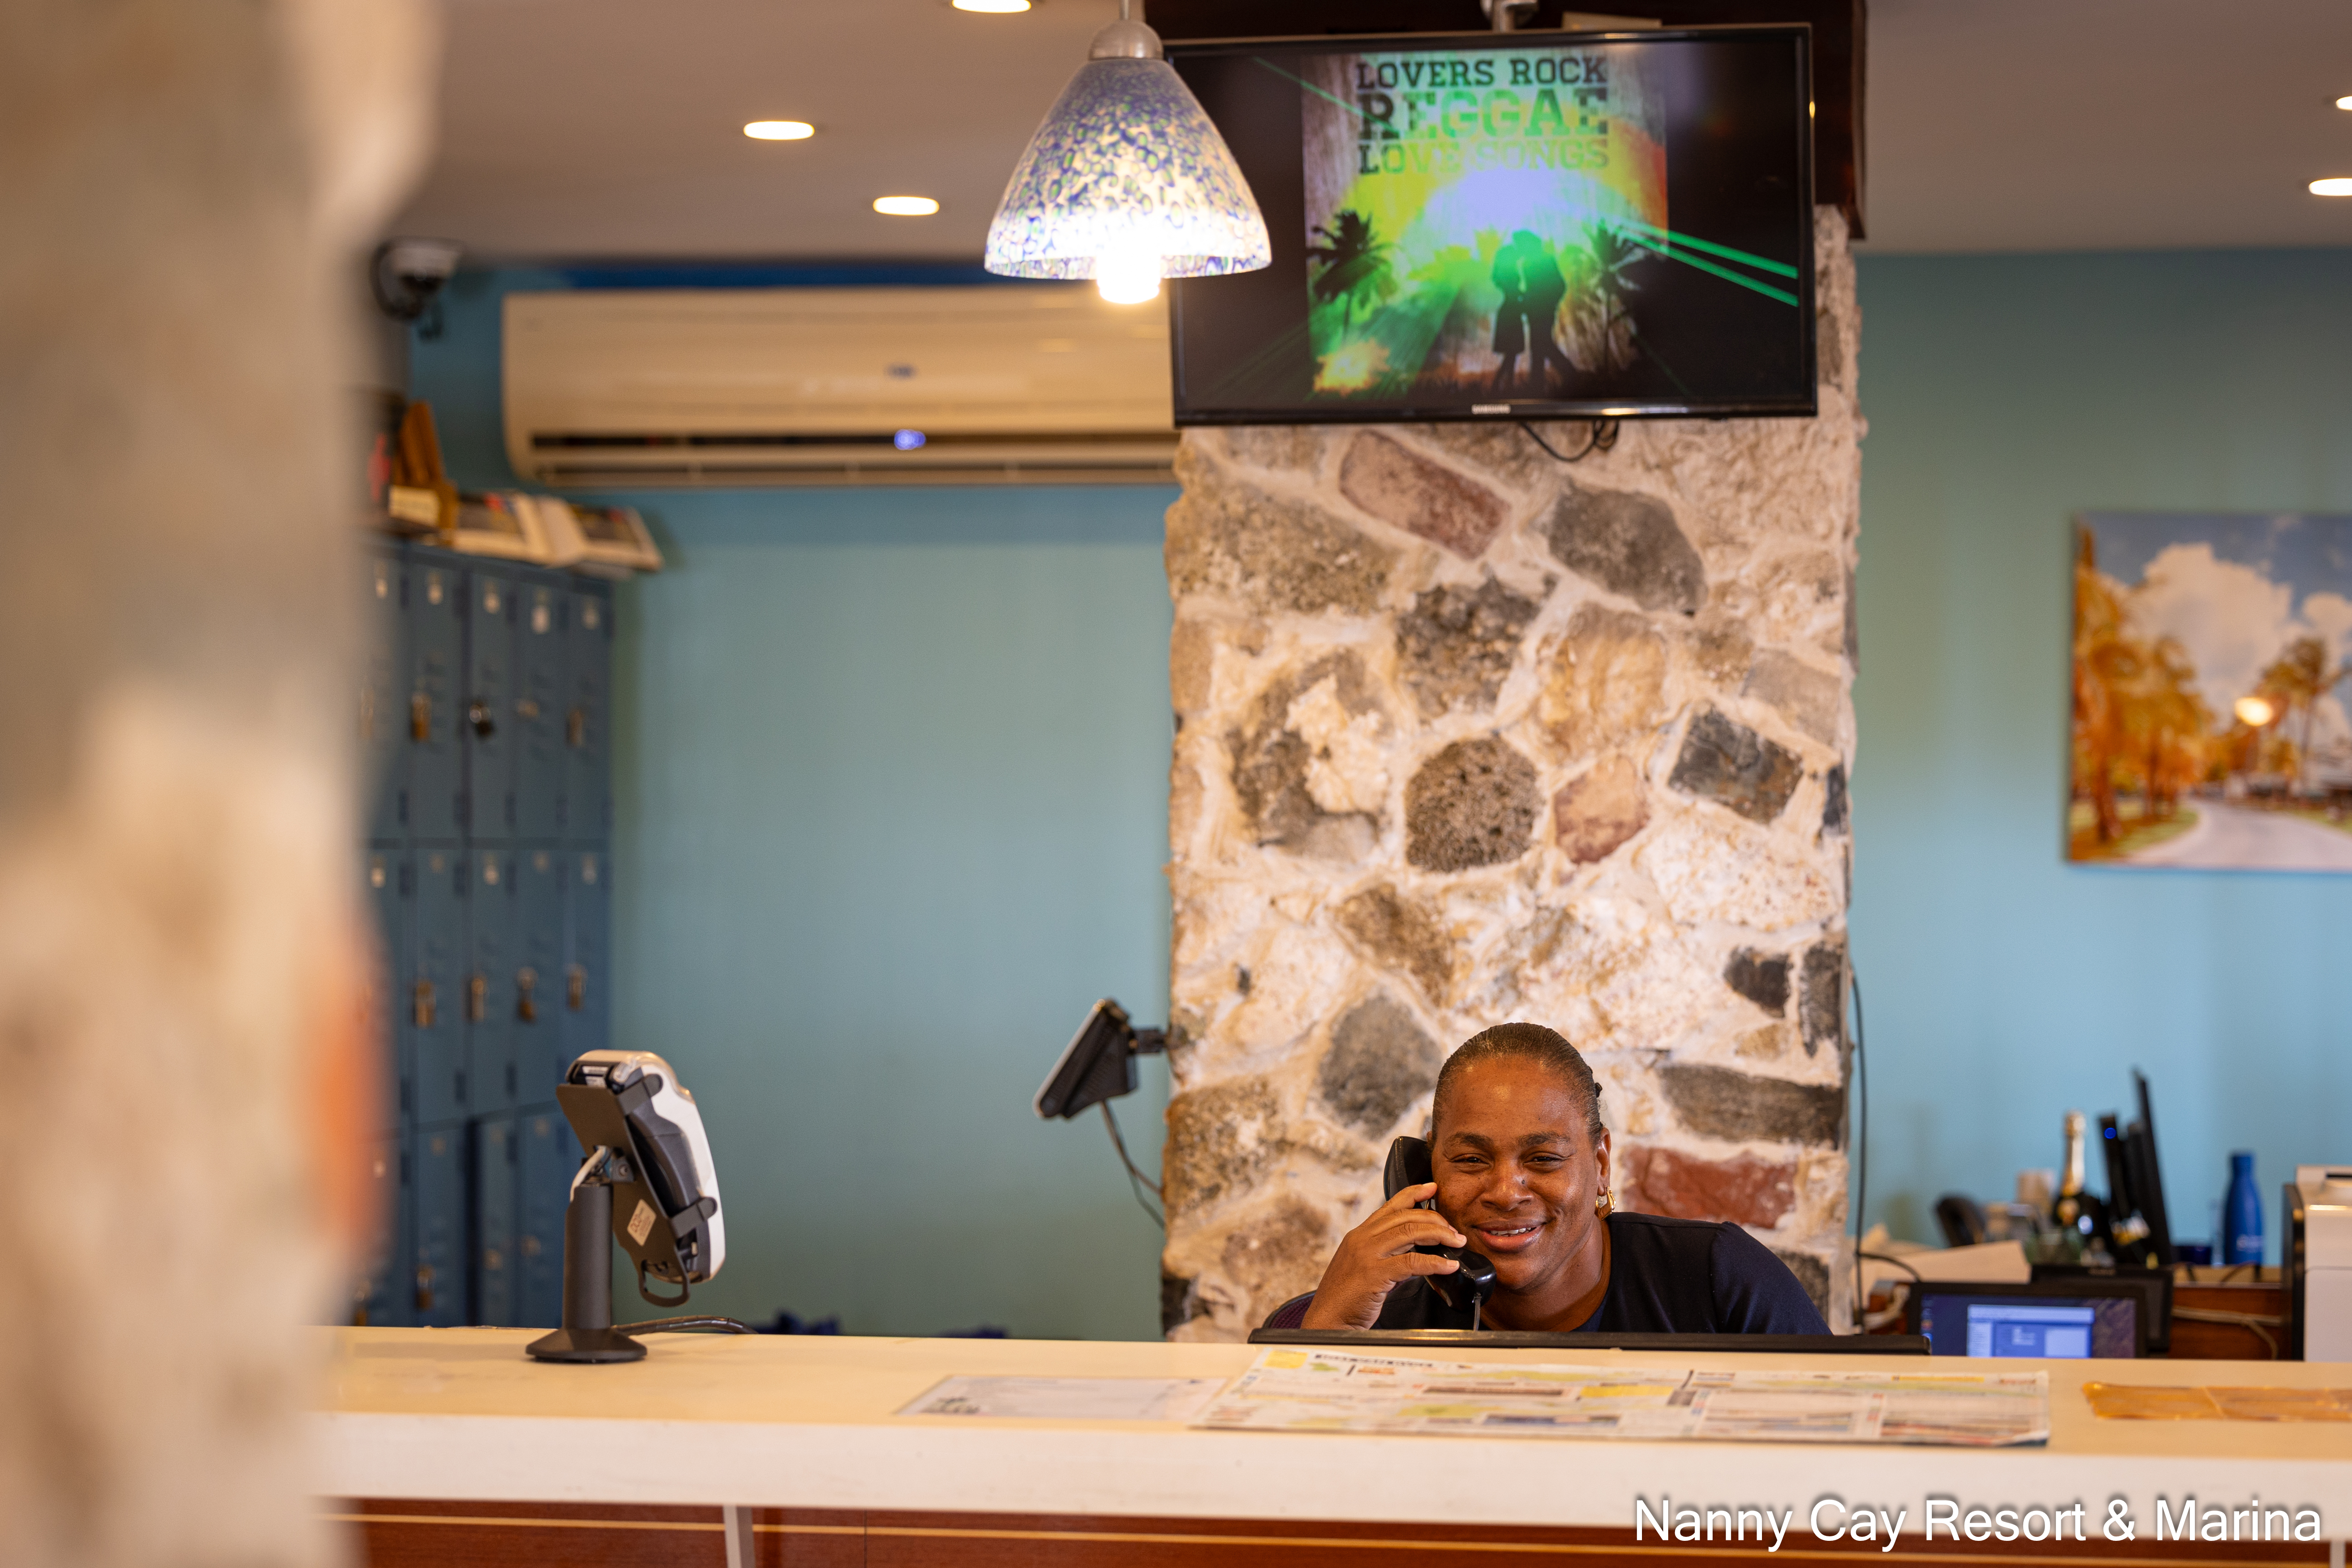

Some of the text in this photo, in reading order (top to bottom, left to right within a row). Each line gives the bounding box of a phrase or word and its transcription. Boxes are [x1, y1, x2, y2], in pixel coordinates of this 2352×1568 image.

[1357, 56, 1608, 88] LOVERS ROCK
[1358, 88, 1608, 139] REGGAE
[1358, 139, 1609, 175] LOVE SONGS
